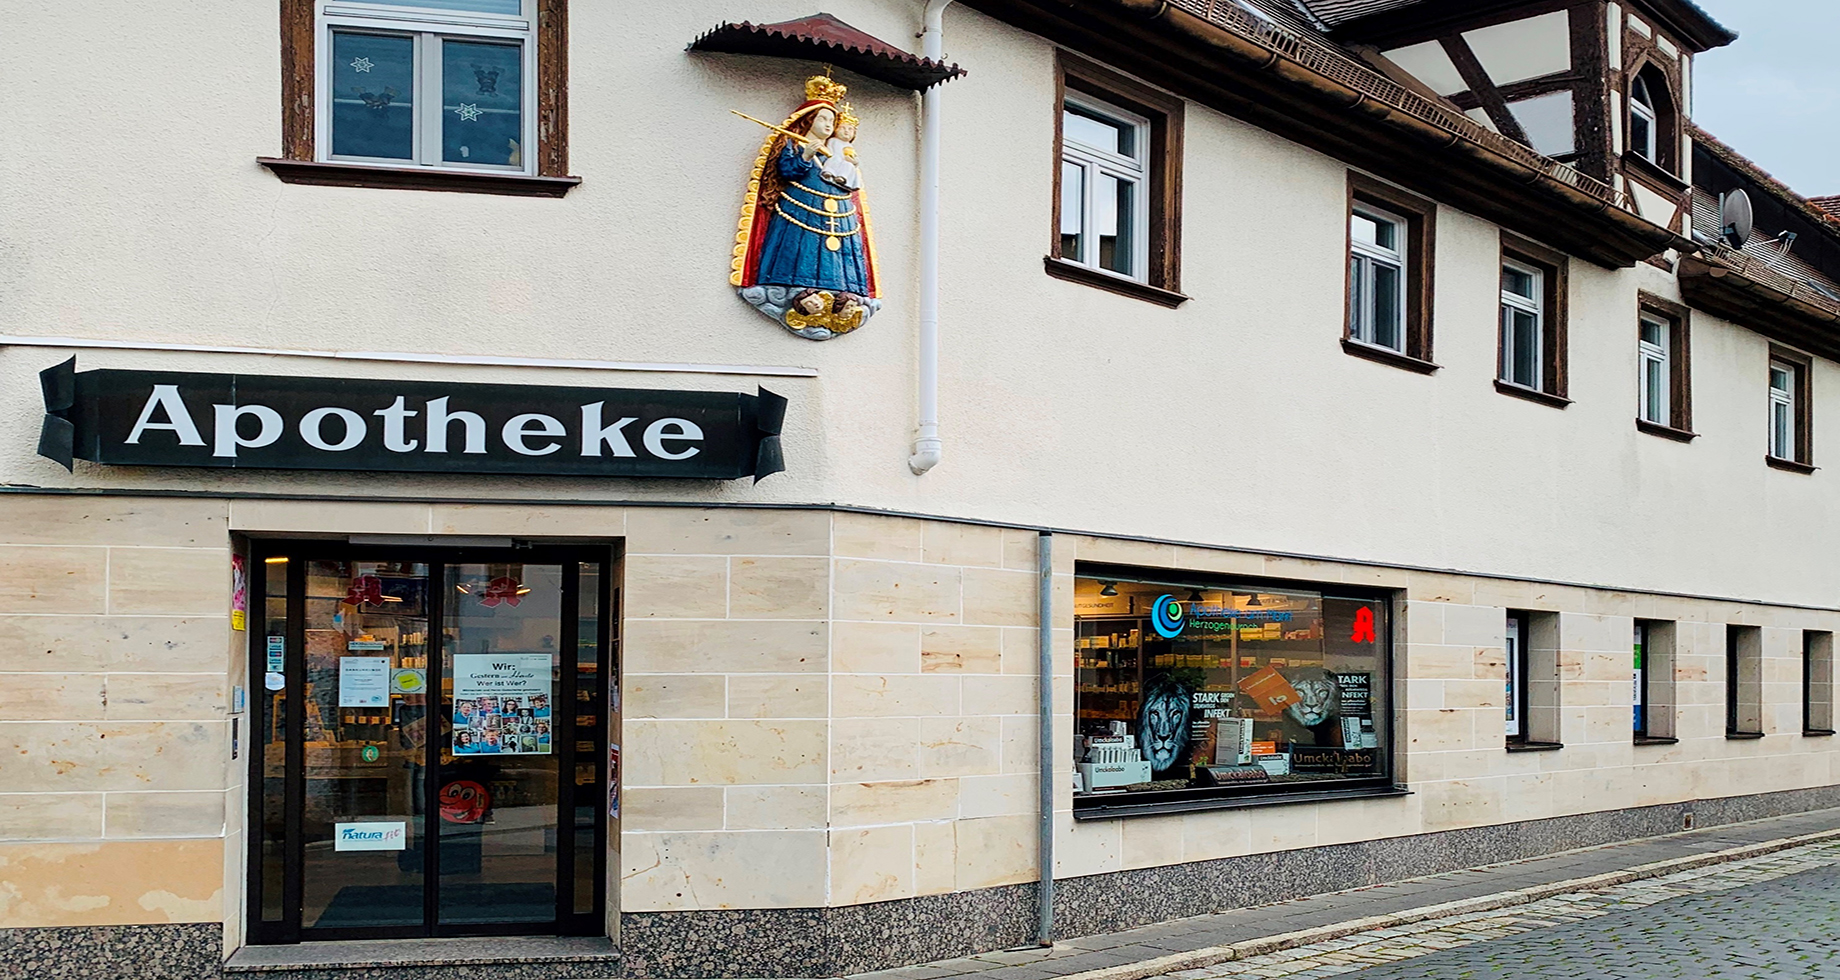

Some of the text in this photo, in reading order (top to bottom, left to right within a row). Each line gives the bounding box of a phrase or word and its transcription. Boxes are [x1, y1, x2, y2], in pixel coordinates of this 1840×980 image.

[124, 384, 704, 460] Apotheke
[1190, 602, 1292, 622] Apotheke am Markt
[492, 663, 516, 671] Wir:
[1337, 675, 1367, 684] TARK
[1192, 692, 1220, 703] STARK
[1341, 691, 1369, 699] NFEKT
[1203, 709, 1231, 719] INFEKT
[1293, 752, 1372, 764] Umcklabo
[342, 828, 383, 840] natura
